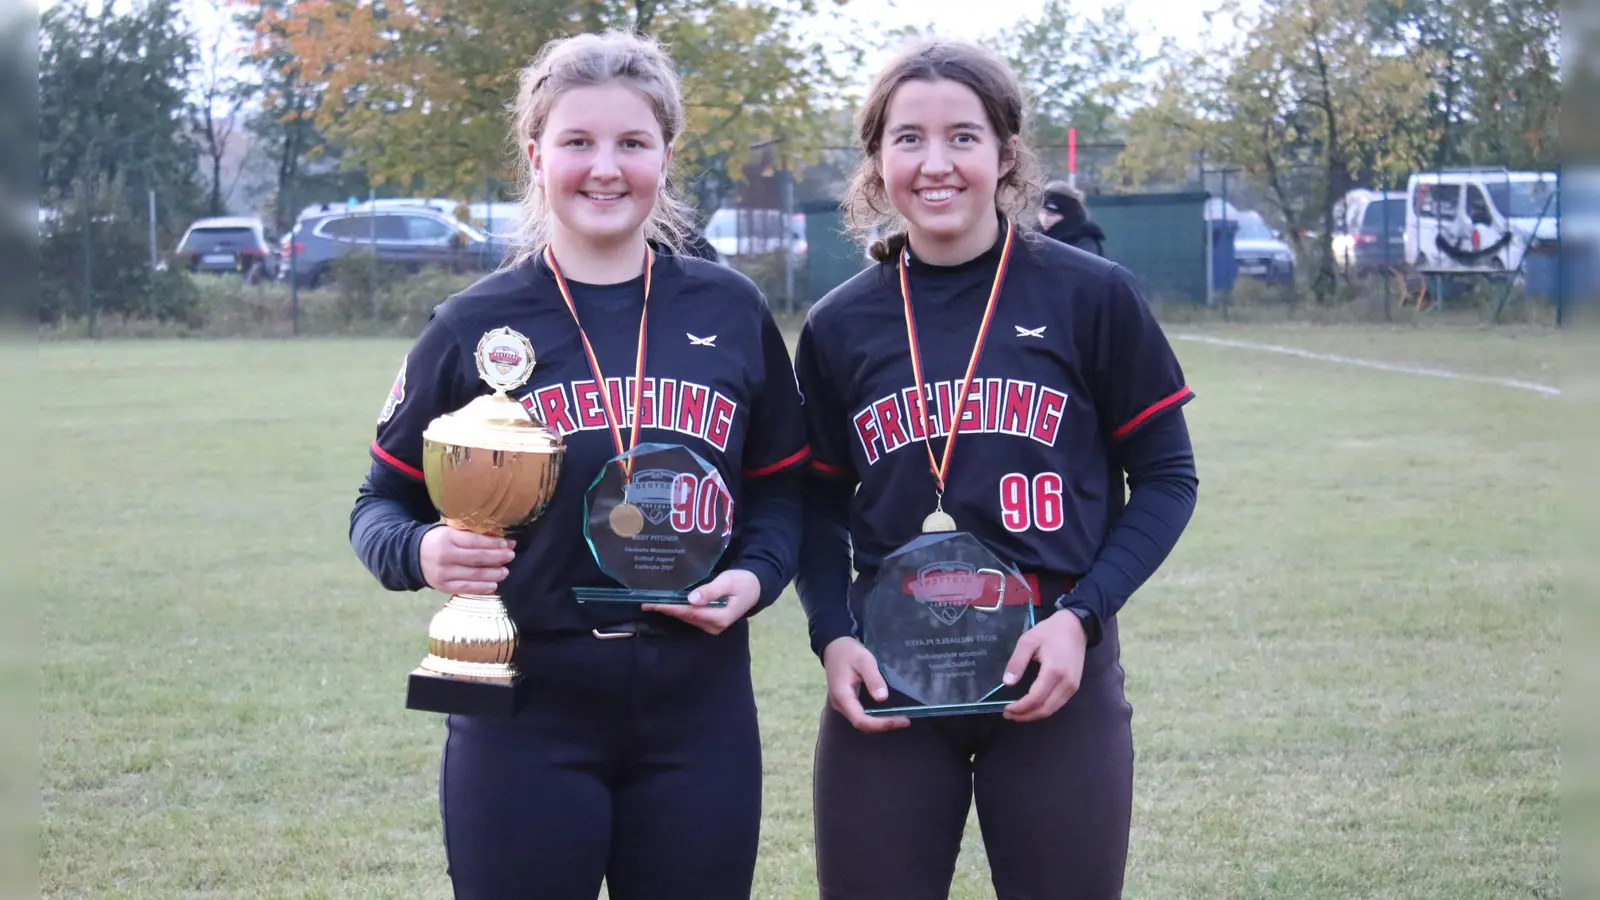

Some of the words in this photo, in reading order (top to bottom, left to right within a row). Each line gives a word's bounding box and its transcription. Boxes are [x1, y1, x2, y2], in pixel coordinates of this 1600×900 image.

[853, 378, 1069, 466] FREISING
[671, 473, 720, 534] 90
[1000, 472, 1064, 532] 96
[650, 534, 679, 542] PITCHER
